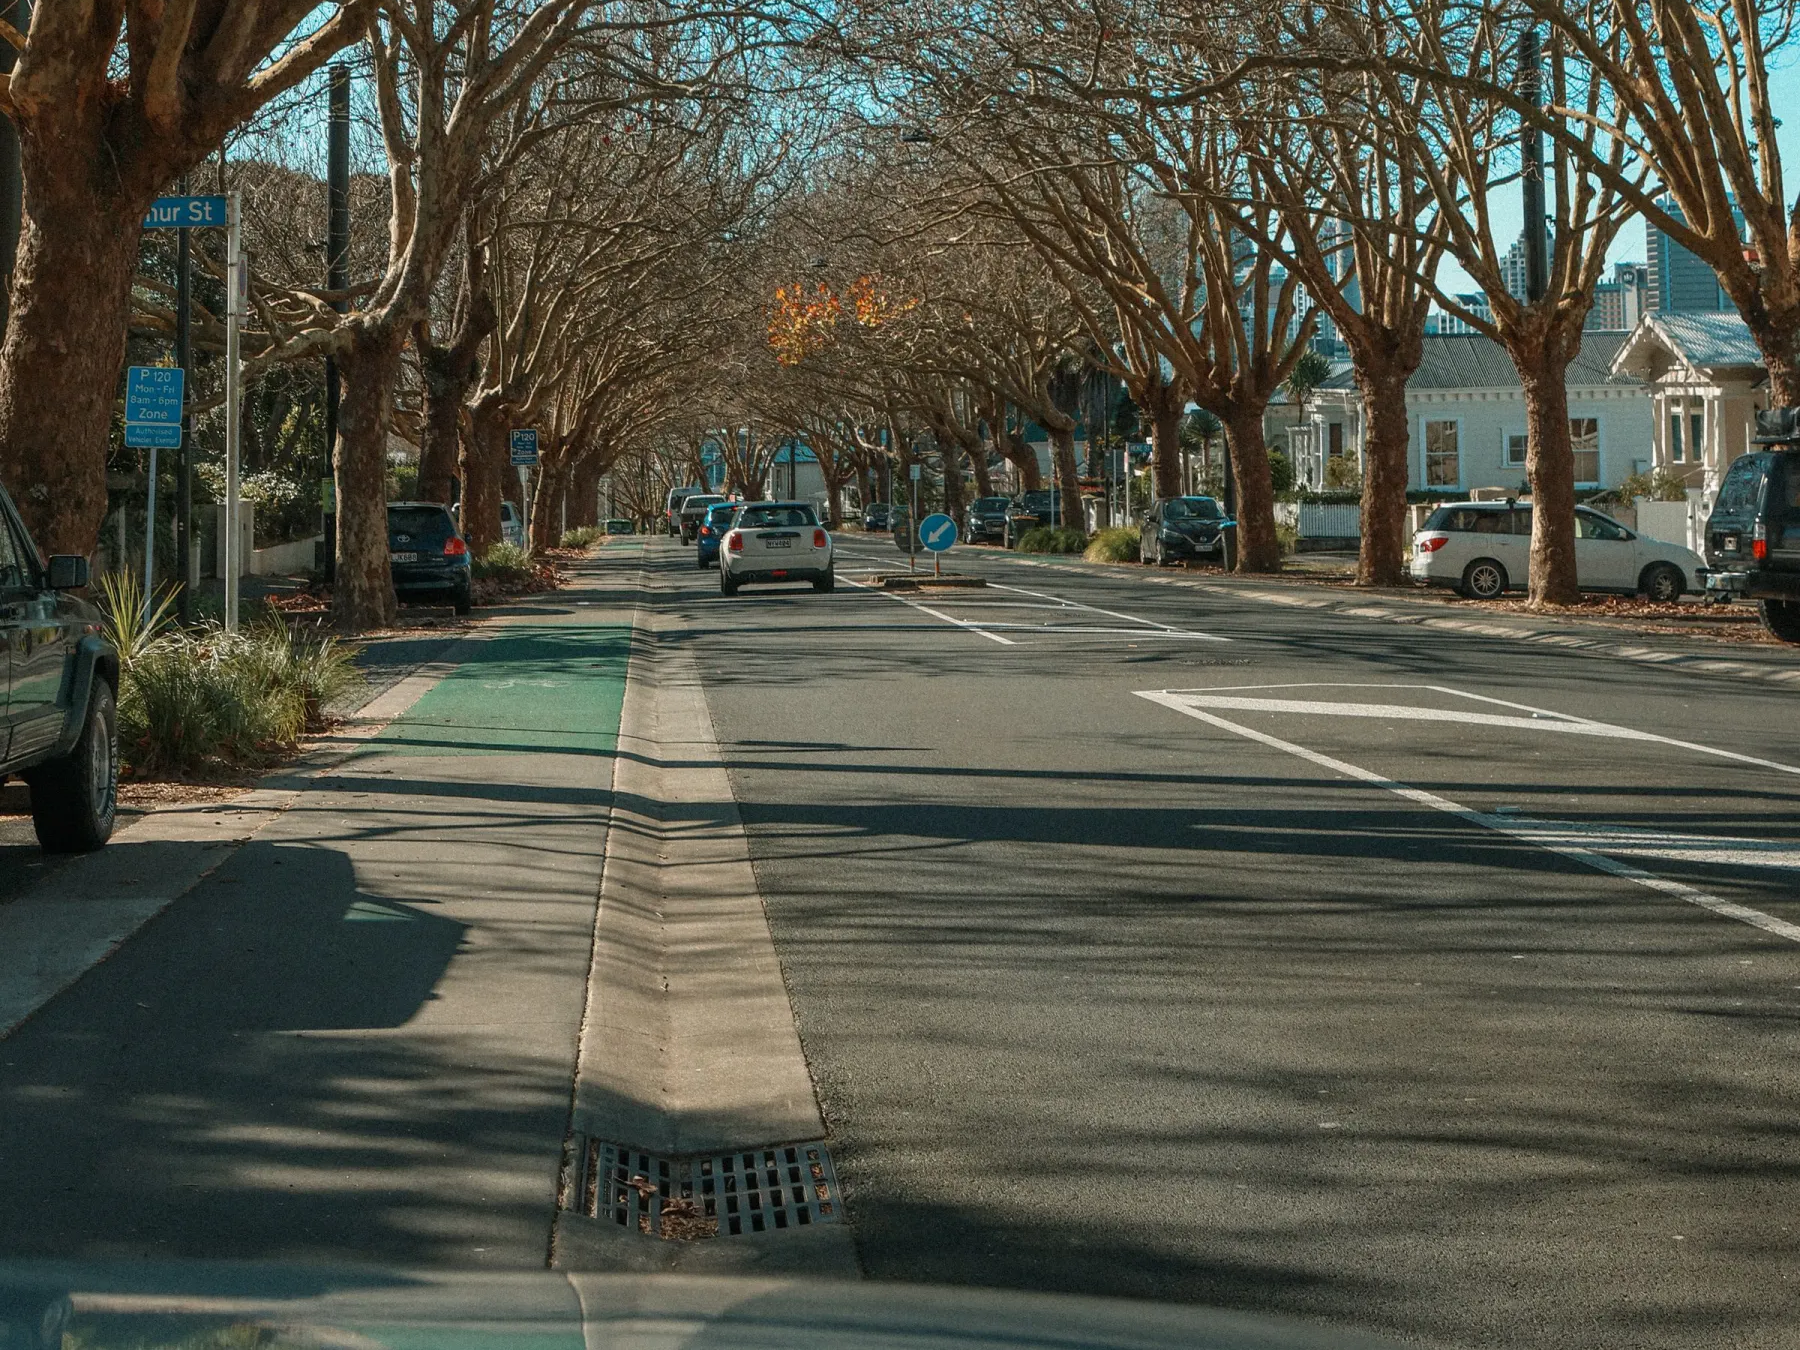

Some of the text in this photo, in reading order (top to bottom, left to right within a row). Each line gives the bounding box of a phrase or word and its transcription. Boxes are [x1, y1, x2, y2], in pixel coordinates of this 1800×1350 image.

[189, 201, 212, 221] St
[141, 369, 171, 382] P 120
[135, 384, 155, 393] Mon
[163, 385, 175, 394] Fri
[130, 395, 151, 404] 8am
[158, 396, 178, 406] 6pm
[139, 408, 168, 419] Zone
